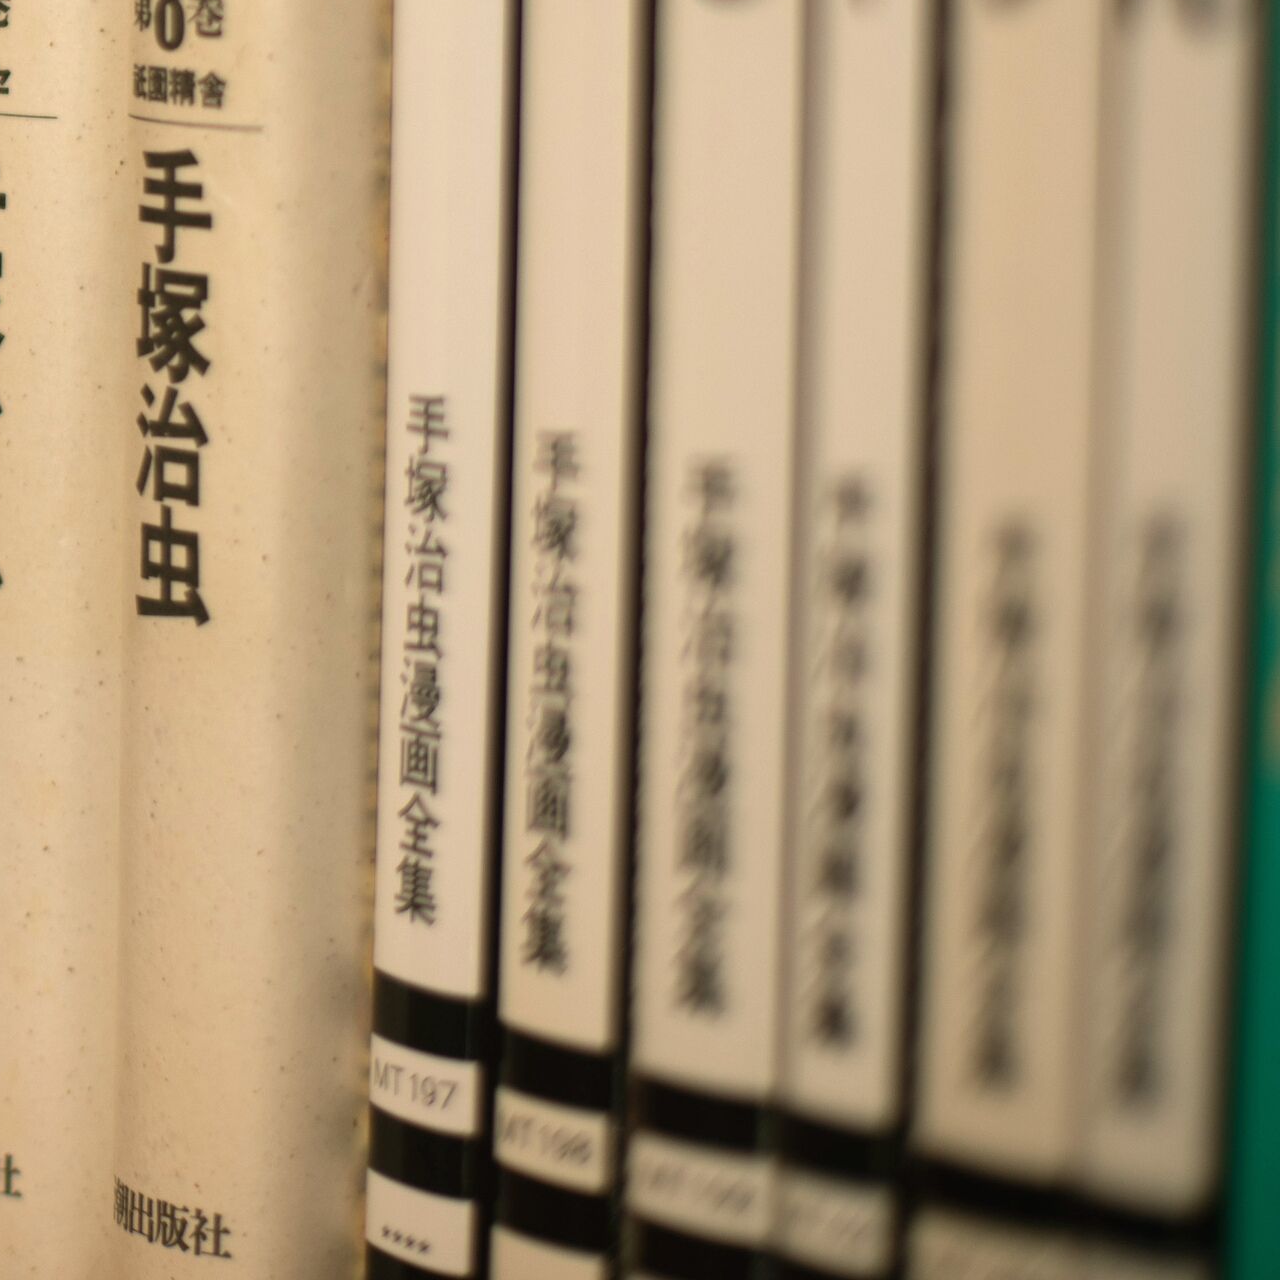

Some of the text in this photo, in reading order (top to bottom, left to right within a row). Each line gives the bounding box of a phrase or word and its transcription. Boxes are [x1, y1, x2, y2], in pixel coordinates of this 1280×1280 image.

[136, 149, 212, 627] 手塚治虫
[394, 393, 450, 925] 手塚治虫漫画全集
